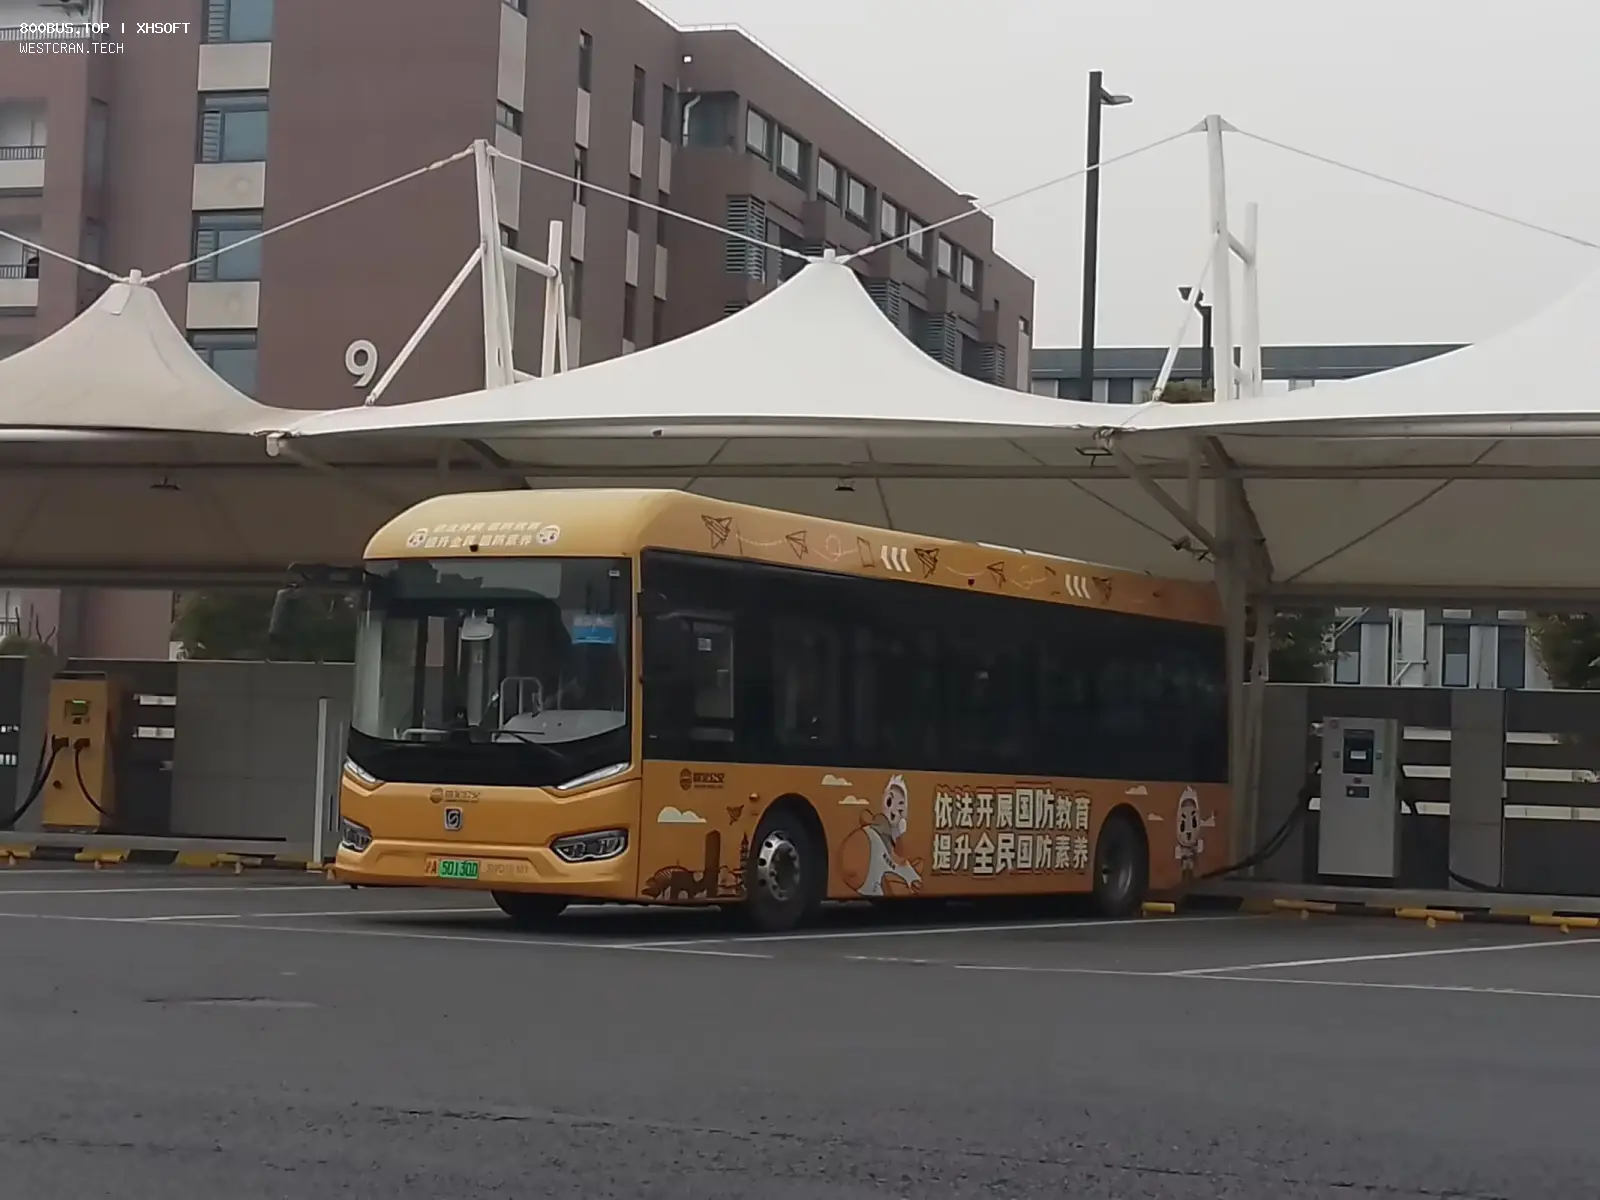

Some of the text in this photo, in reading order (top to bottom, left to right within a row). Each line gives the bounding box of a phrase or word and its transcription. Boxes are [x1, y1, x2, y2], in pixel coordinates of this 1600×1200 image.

[345, 339, 378, 387] 9
[934, 788, 1091, 831] 依法开展国防教育
[932, 831, 1089, 874] 提升全民国防素养
